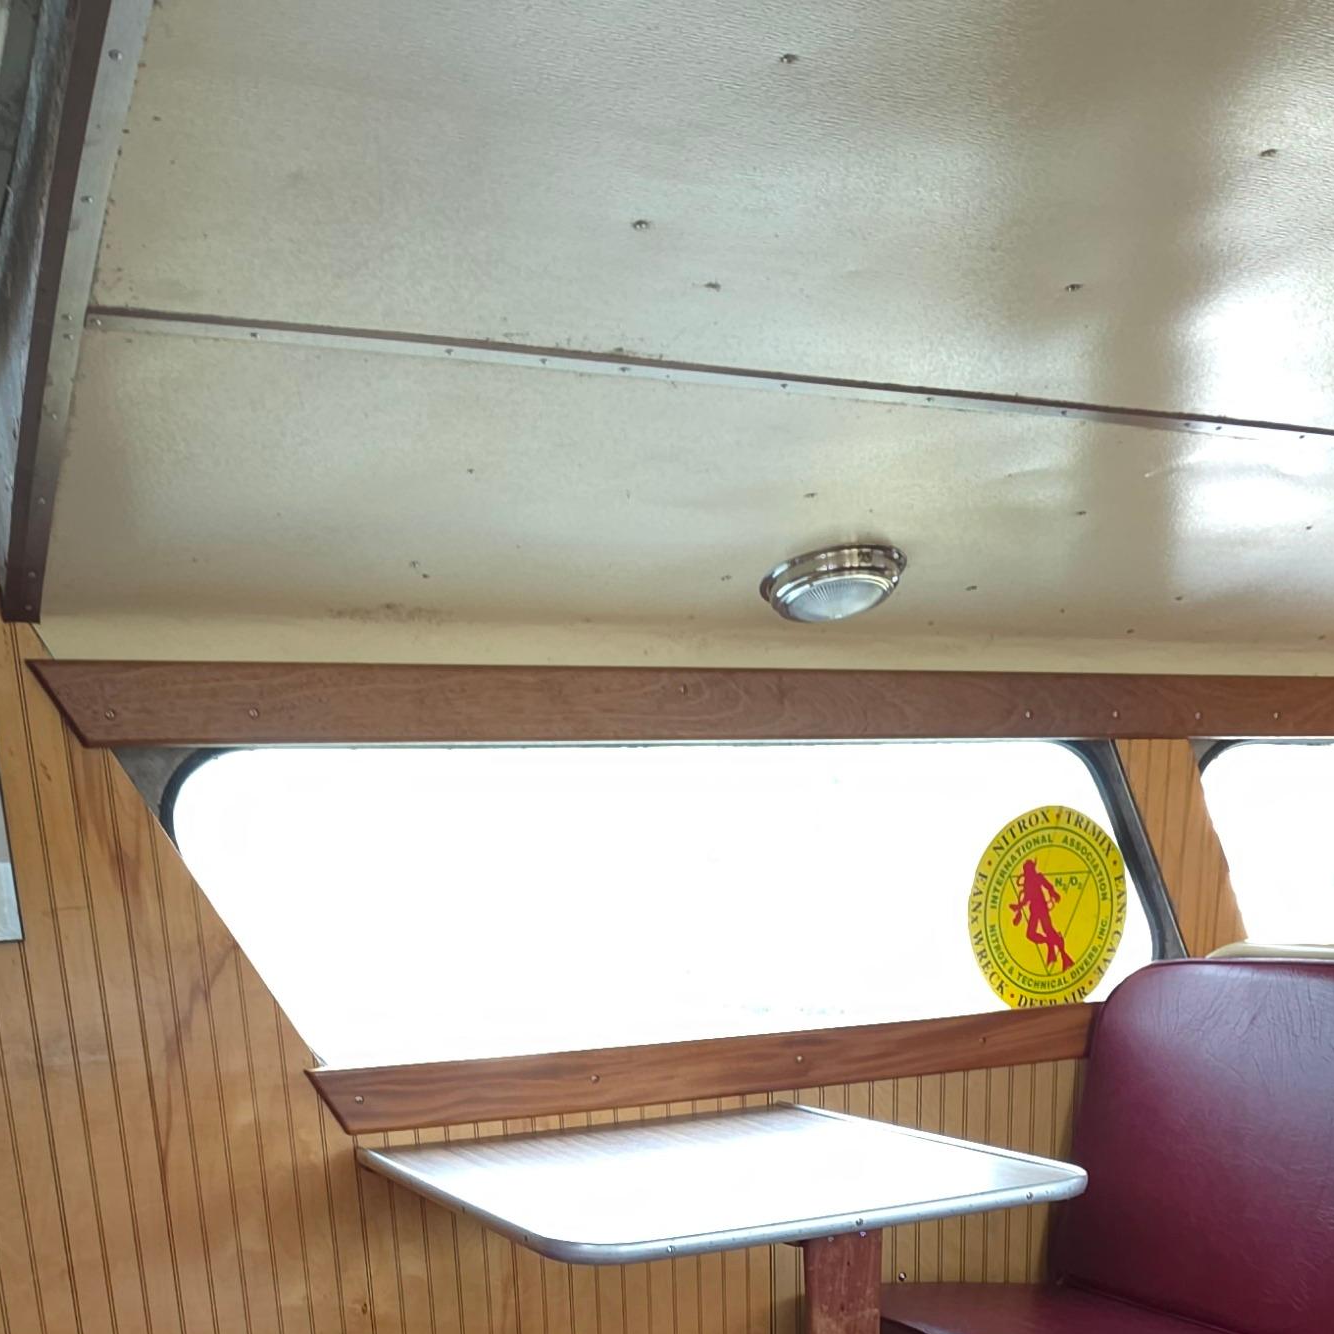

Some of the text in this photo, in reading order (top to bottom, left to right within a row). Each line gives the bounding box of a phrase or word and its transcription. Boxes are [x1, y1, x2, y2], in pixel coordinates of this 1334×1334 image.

[993, 810, 1050, 857] NITROX
[1065, 811, 1114, 858] TRIMIX
[990, 834, 1107, 909] INTERNATIONAL ASSOCIATION
[973, 930, 1008, 996] WRECK
[989, 924, 1008, 966] NITROX
[1017, 972, 1068, 989] TECHNICAL
